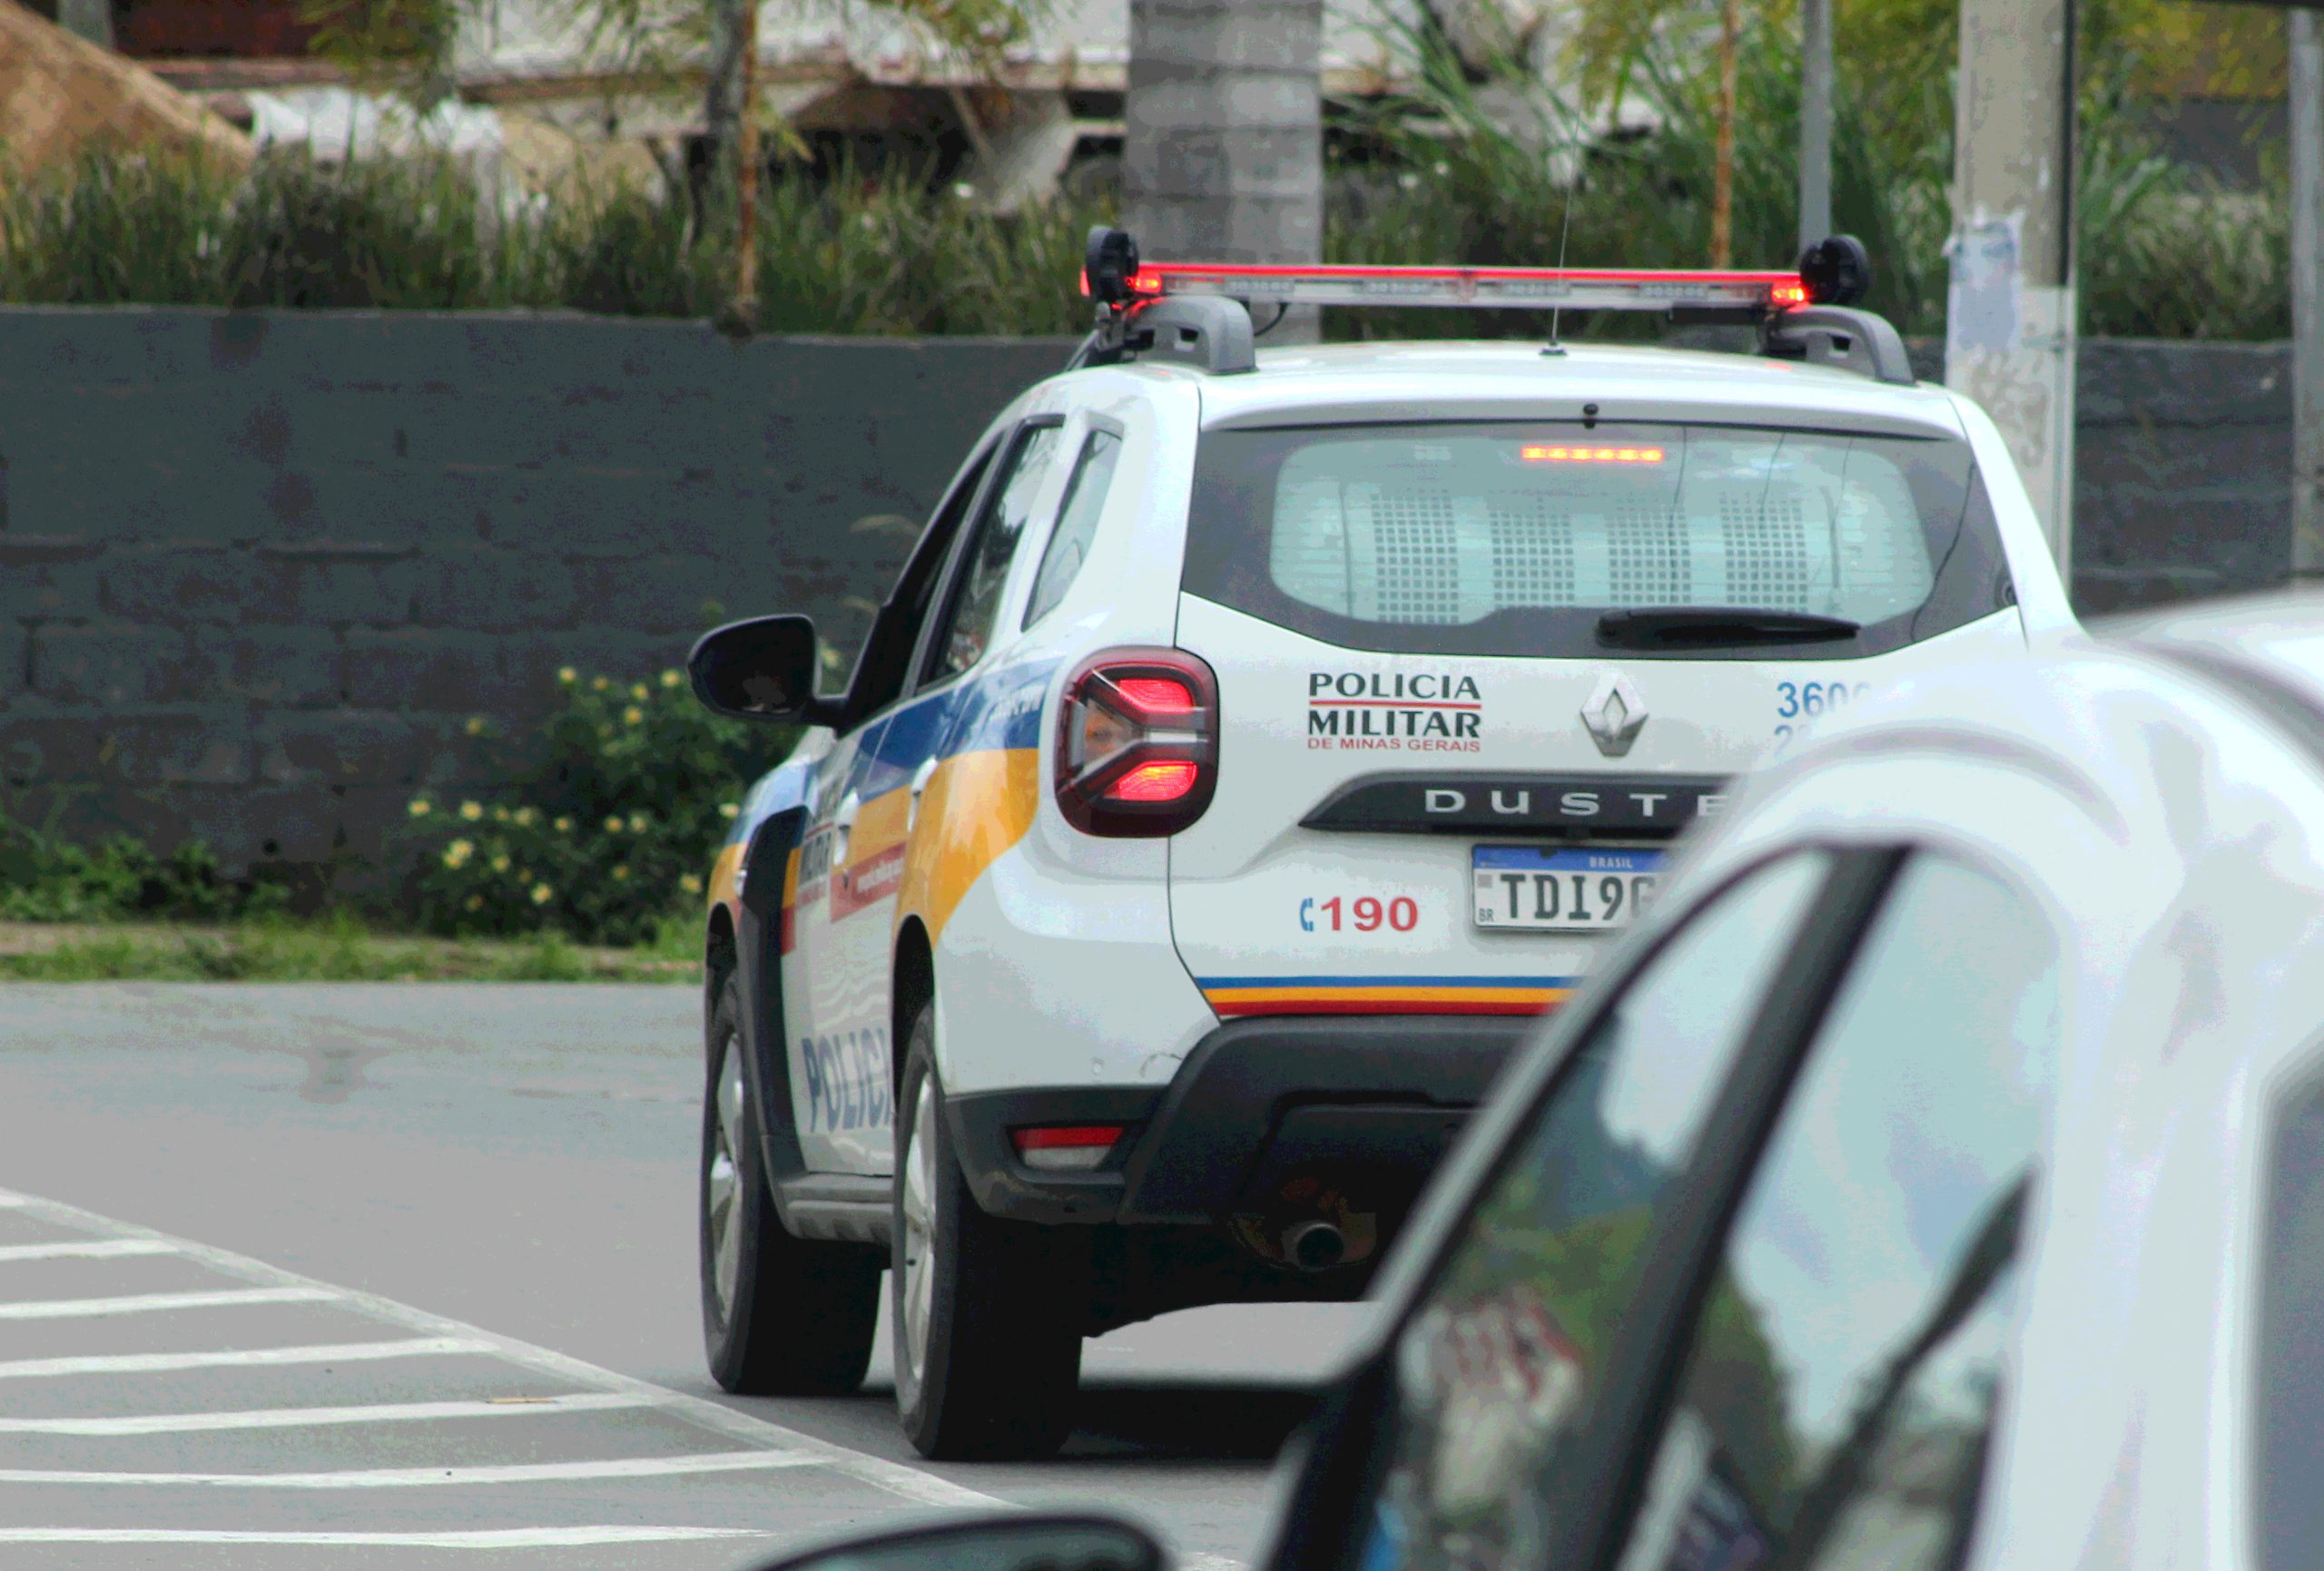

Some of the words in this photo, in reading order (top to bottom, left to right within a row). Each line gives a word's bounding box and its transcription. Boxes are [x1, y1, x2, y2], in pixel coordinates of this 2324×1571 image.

[1308, 672, 1482, 700] POLICIA
[1307, 710, 1482, 738] MILITAR
[1307, 738, 1333, 749] DE
[1340, 738, 1402, 750] MINAS
[1407, 739, 1481, 752] GERAIS
[1590, 856, 1633, 869] BRASIL
[1320, 896, 1419, 932] 190
[1479, 908, 1494, 922] BR
